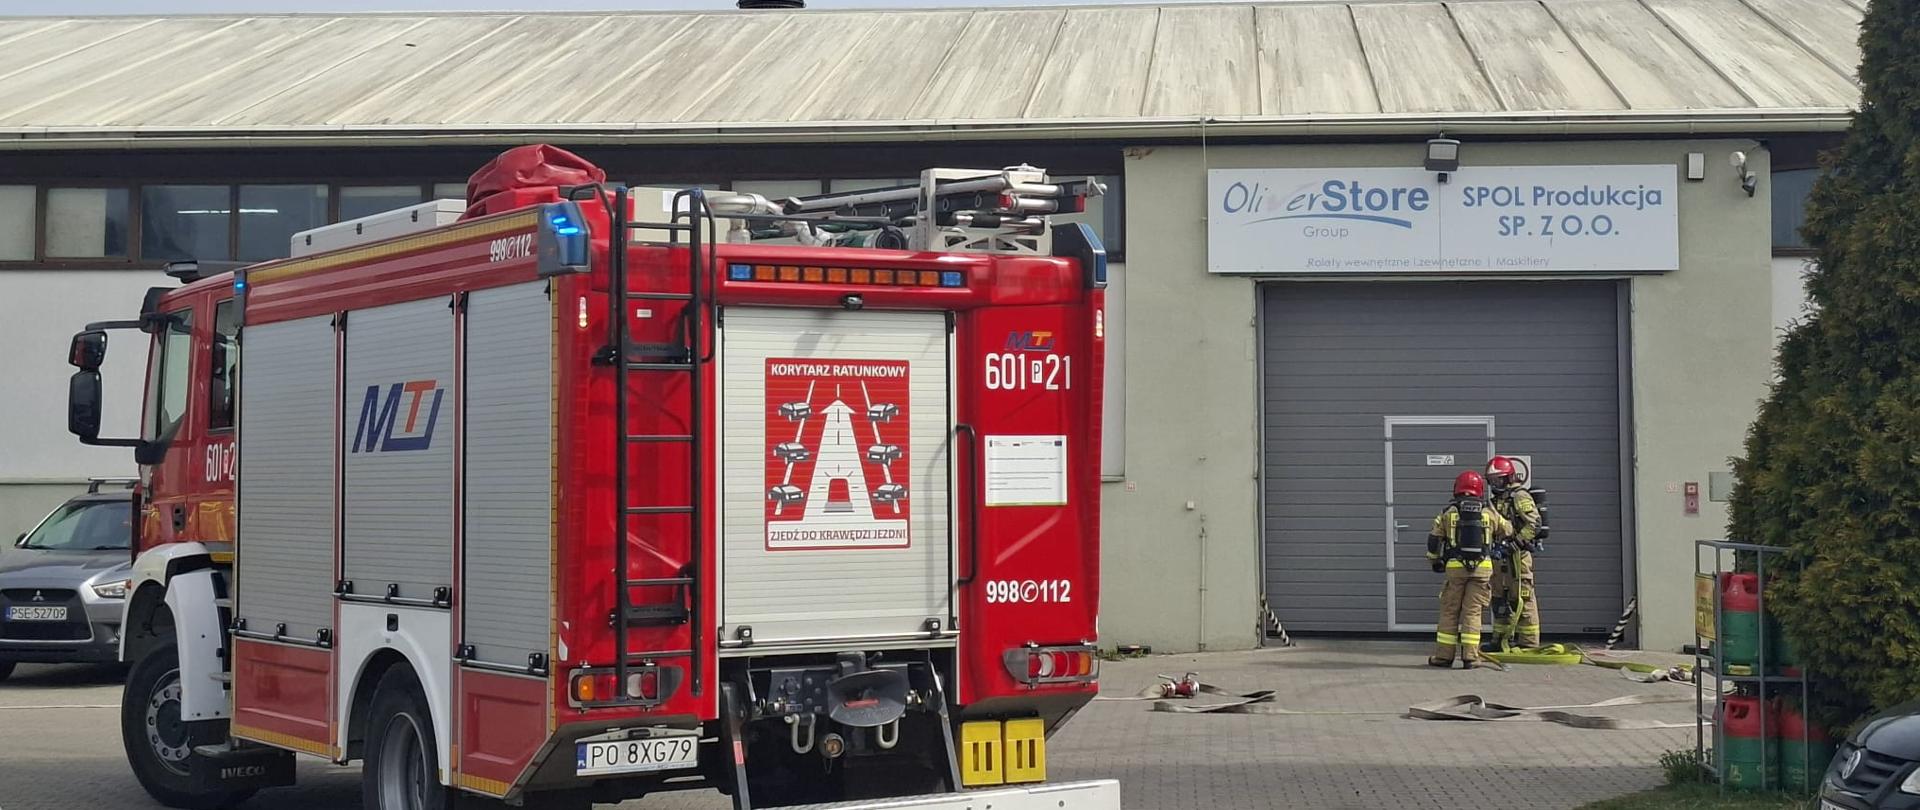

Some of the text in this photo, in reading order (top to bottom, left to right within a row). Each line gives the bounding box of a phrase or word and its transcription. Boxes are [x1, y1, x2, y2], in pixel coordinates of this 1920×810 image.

[1462, 184, 1662, 210] SPOL Produkcja
[1303, 225, 1349, 239] Group
[1498, 215, 1619, 236] SP. Z O.O.
[490, 233, 531, 262] 998 112
[771, 364, 906, 377] KORYTARZ RATUNKOWY
[985, 353, 1025, 390] 601
[1046, 354, 1071, 390] 21
[206, 443, 223, 482] 601
[770, 529, 906, 542] ZJEDŹ DO KRAWĘDZI JEZDNI
[986, 579, 1071, 603] 998 112
[34, 607, 66, 619] 52709
[592, 740, 692, 767] PO 8XG79
